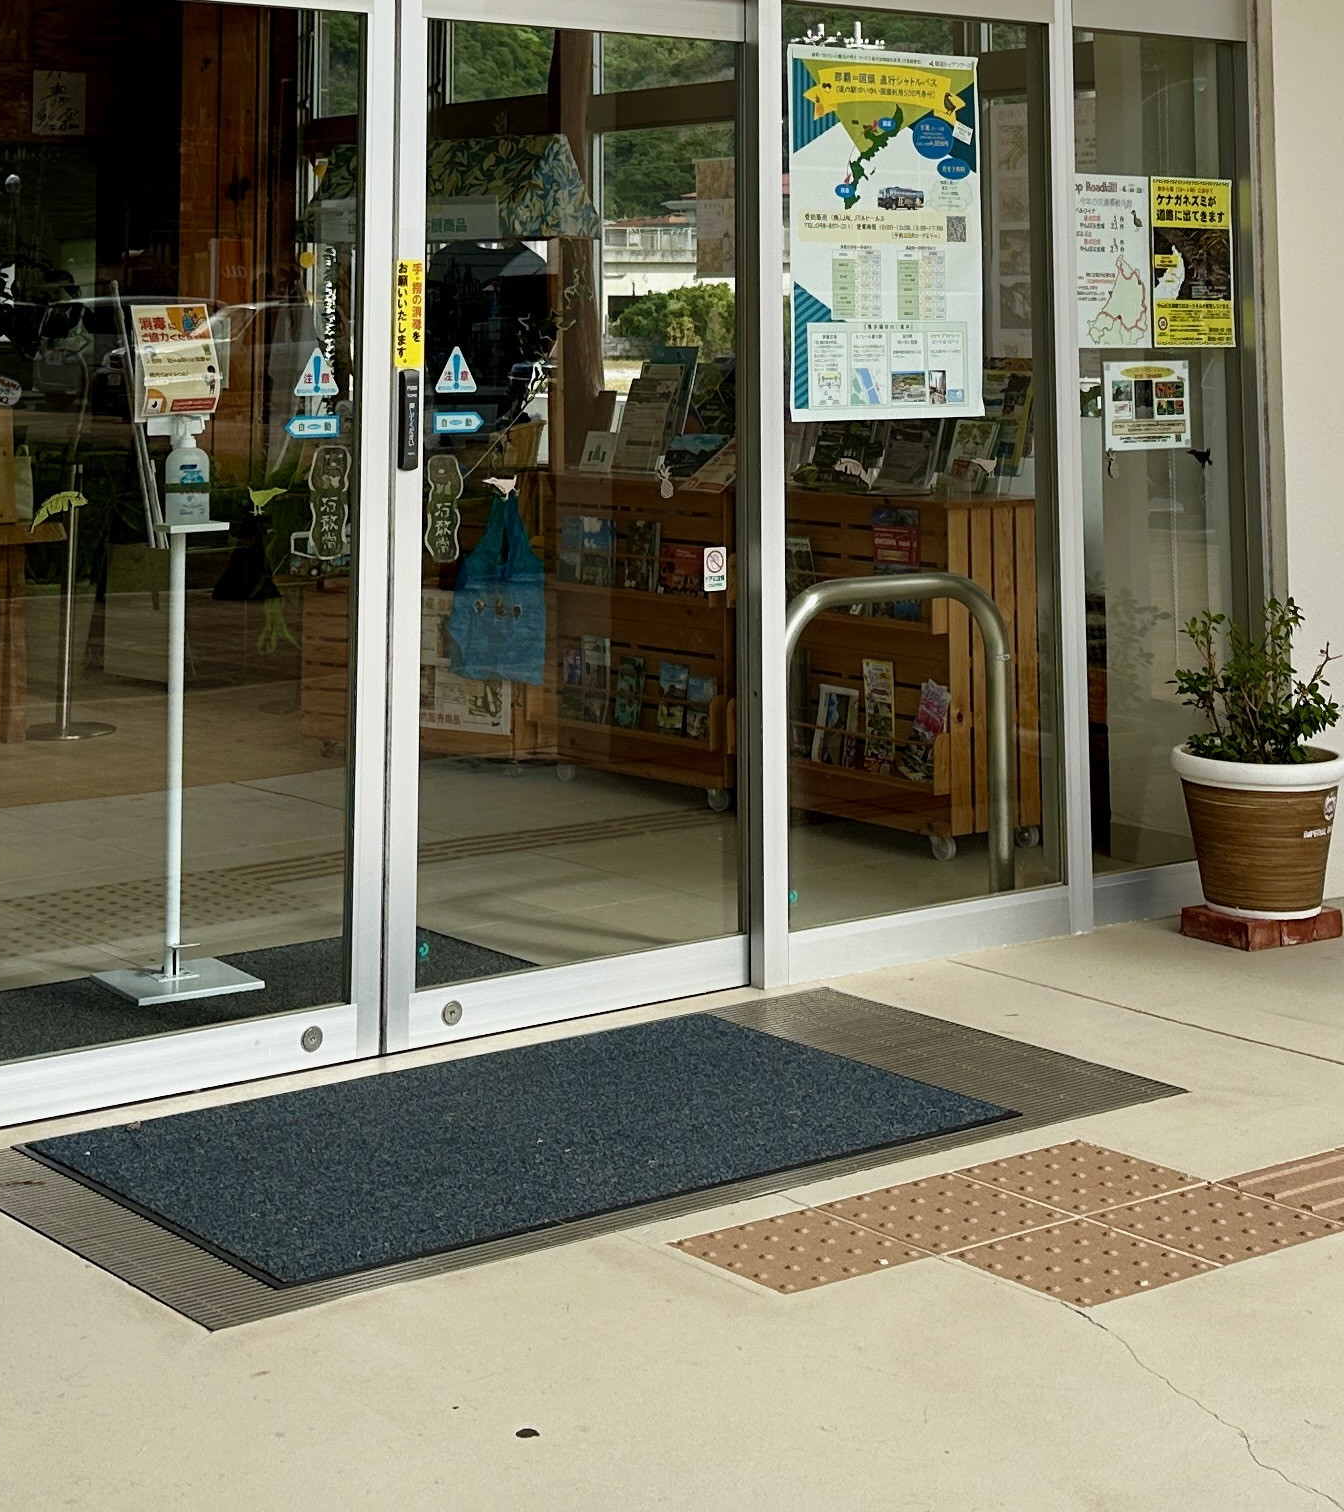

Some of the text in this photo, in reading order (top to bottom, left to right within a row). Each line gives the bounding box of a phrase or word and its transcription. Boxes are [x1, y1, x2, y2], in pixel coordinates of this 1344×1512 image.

[1156, 193, 1217, 208] ケナガネズミが
[1156, 208, 1225, 224] 道路に出てきます
[396, 262, 409, 364] お願いいたします。
